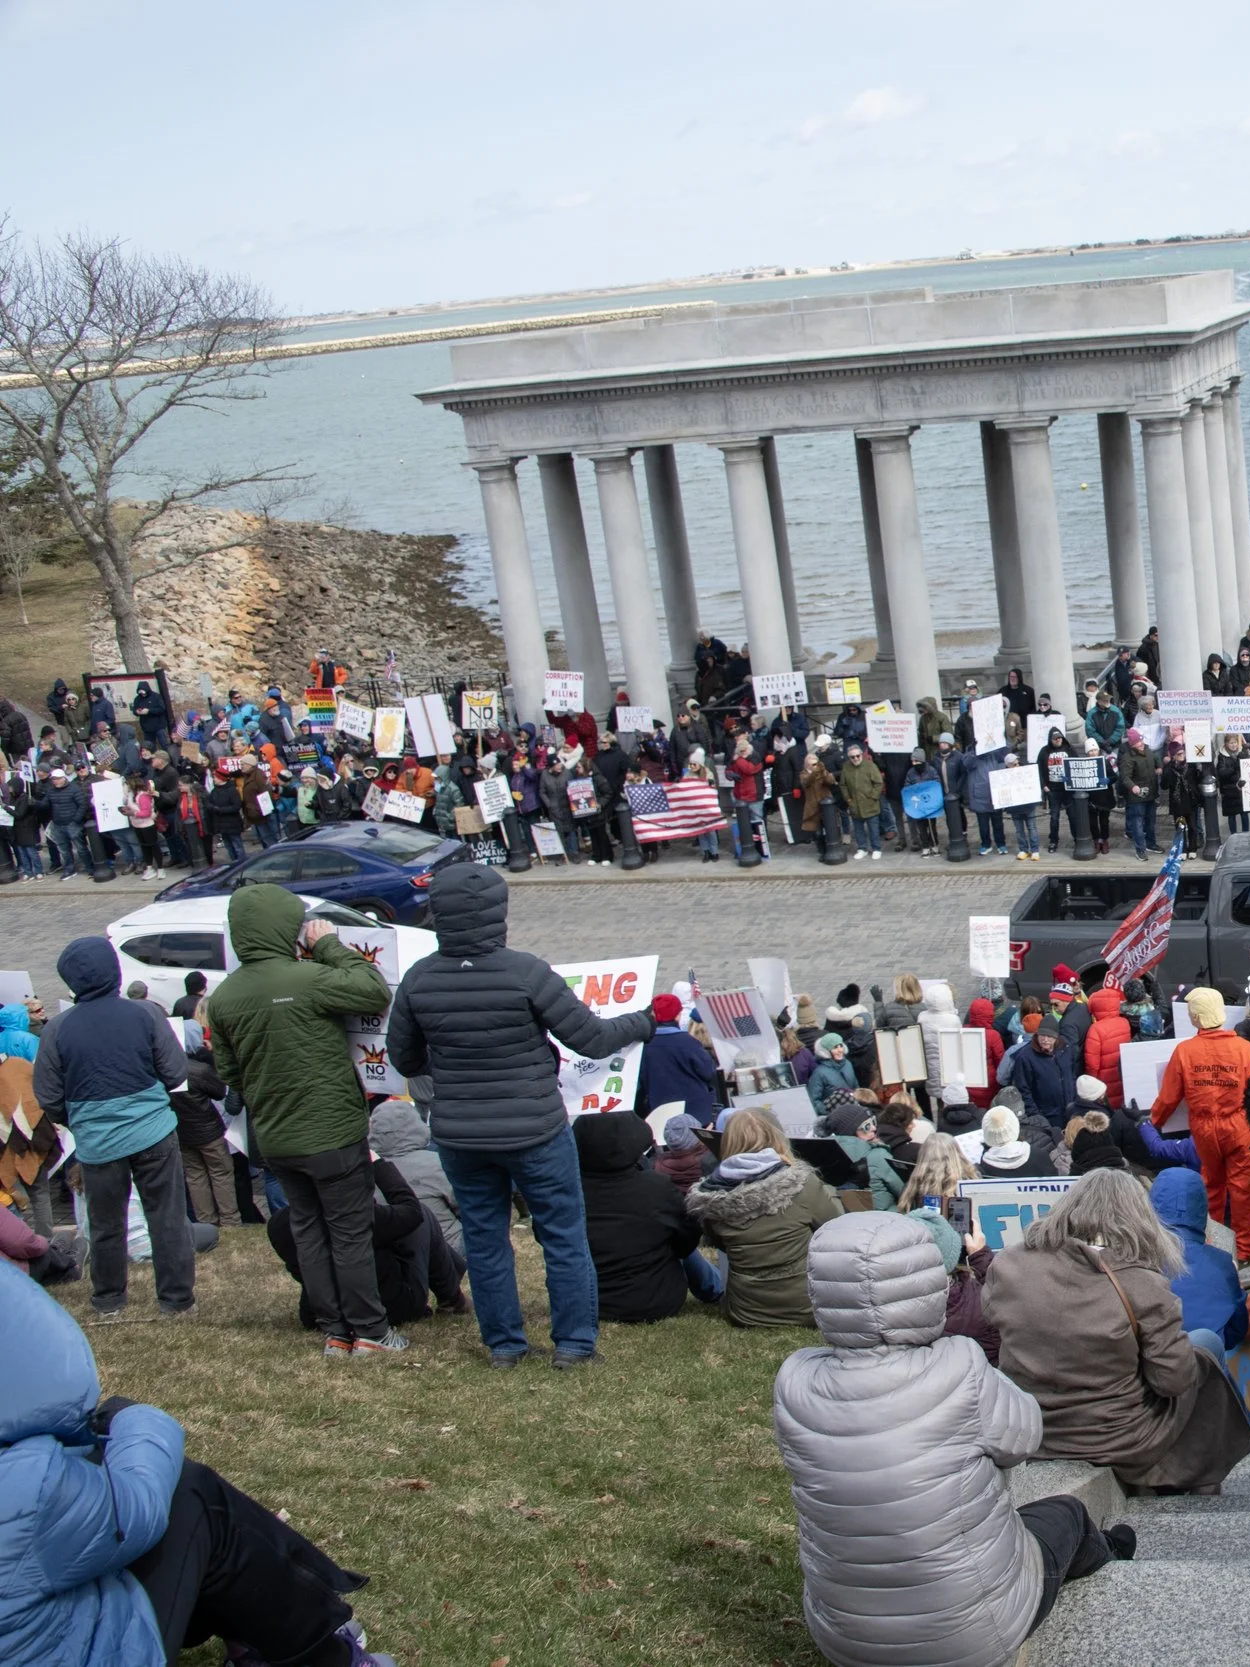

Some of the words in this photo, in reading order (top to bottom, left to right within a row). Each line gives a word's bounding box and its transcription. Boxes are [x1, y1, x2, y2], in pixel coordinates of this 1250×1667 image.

[545, 672, 583, 681] CORRUPTION
[551, 690, 578, 698] KILLING
[560, 699, 568, 707] US
[1227, 698, 1250, 706] MAKE
[342, 703, 367, 719] PEOPLE
[469, 706, 494, 720] NO
[624, 715, 645, 724] NOT
[1069, 759, 1098, 768] VETERANS
[1070, 768, 1099, 777] AGAINST
[1070, 777, 1100, 788] TRUMP
[471, 840, 497, 852] LOVE
[361, 1017, 381, 1028] NO
[573, 1059, 587, 1070] NO
[1193, 1064, 1239, 1073] DEPARTMENT
[365, 1064, 386, 1076] NO
[1193, 1080, 1239, 1088] CORRECTIONS
